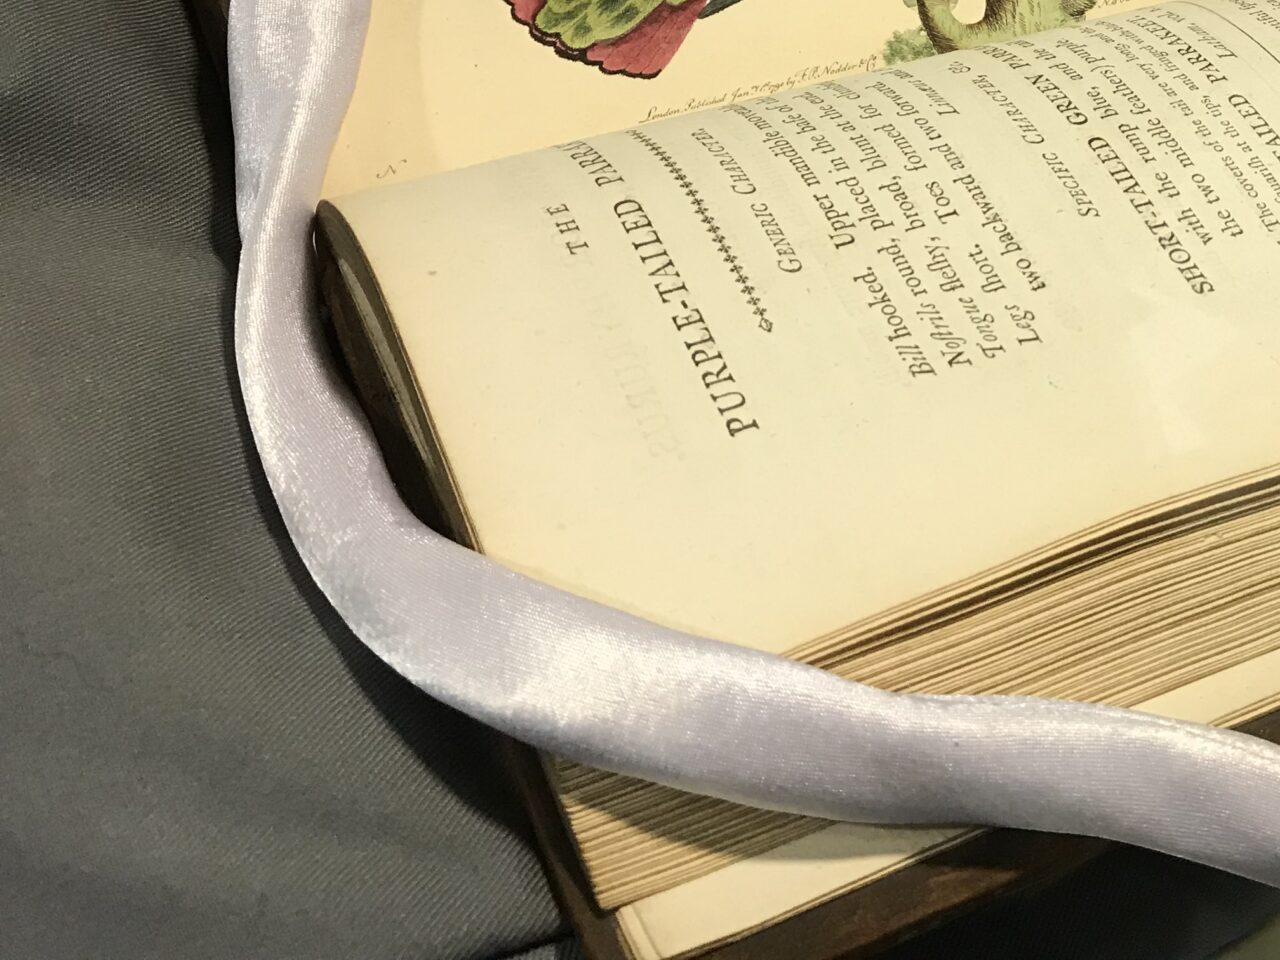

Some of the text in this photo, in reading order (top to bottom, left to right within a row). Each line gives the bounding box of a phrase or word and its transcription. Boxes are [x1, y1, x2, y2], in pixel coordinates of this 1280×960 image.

[1031, 47, 1057, 60] the
[1088, 31, 1116, 44] and
[1113, 42, 1140, 63] long,
[1126, 14, 1228, 84] PARRAKEET.
[1048, 61, 1084, 81] and
[1135, 62, 1160, 79] very
[1137, 43, 1180, 73] fringed
[785, 76, 795, 88] by
[865, 80, 920, 117] forward.
[1091, 63, 1152, 115] feathers)
[1156, 80, 1178, 98] are
[1171, 72, 1200, 91] and
[818, 103, 843, 120] the
[856, 102, 883, 120] for
[971, 73, 1045, 145] CHARACTER,
[1023, 73, 1089, 126] GREEN
[1085, 85, 1119, 119] blue,
[1168, 98, 1194, 117] tail
[1199, 94, 1223, 118] tips,
[835, 119, 857, 133] at
[913, 116, 942, 141] two
[1117, 122, 1157, 164] rump
[1145, 116, 1195, 168] middle
[1190, 118, 1212, 137] the
[1219, 119, 1240, 138] the
[761, 129, 821, 187] mandible
[809, 133, 836, 154] the
[848, 133, 888, 172] blunt
[872, 122, 928, 172] formed
[928, 142, 965, 171] and
[1201, 139, 1224, 153] of
[1235, 140, 1253, 153] at
[826, 155, 850, 174] in
[1220, 154, 1259, 198] coverts
[924, 180, 960, 222] Toes
[1041, 151, 1101, 217] SPECIFIC
[1153, 170, 1181, 198] the
[1190, 172, 1221, 204] two
[834, 175, 895, 230] placed
[877, 174, 926, 232] broad,
[951, 173, 1023, 256] backward
[1086, 136, 1214, 294] SHORT-TAILED
[545, 202, 589, 254] THE
[749, 202, 803, 273] GENERIC
[812, 193, 856, 248] Upper
[1176, 206, 1213, 244] with
[1216, 208, 1244, 237] the
[876, 237, 928, 297] round,
[1015, 257, 1047, 291] two
[613, 198, 759, 435] PURPLE-TAILED
[852, 265, 912, 342] hooked.
[957, 296, 1006, 357] Tongue
[1003, 303, 1043, 346] Legs
[894, 343, 938, 378] Bill
